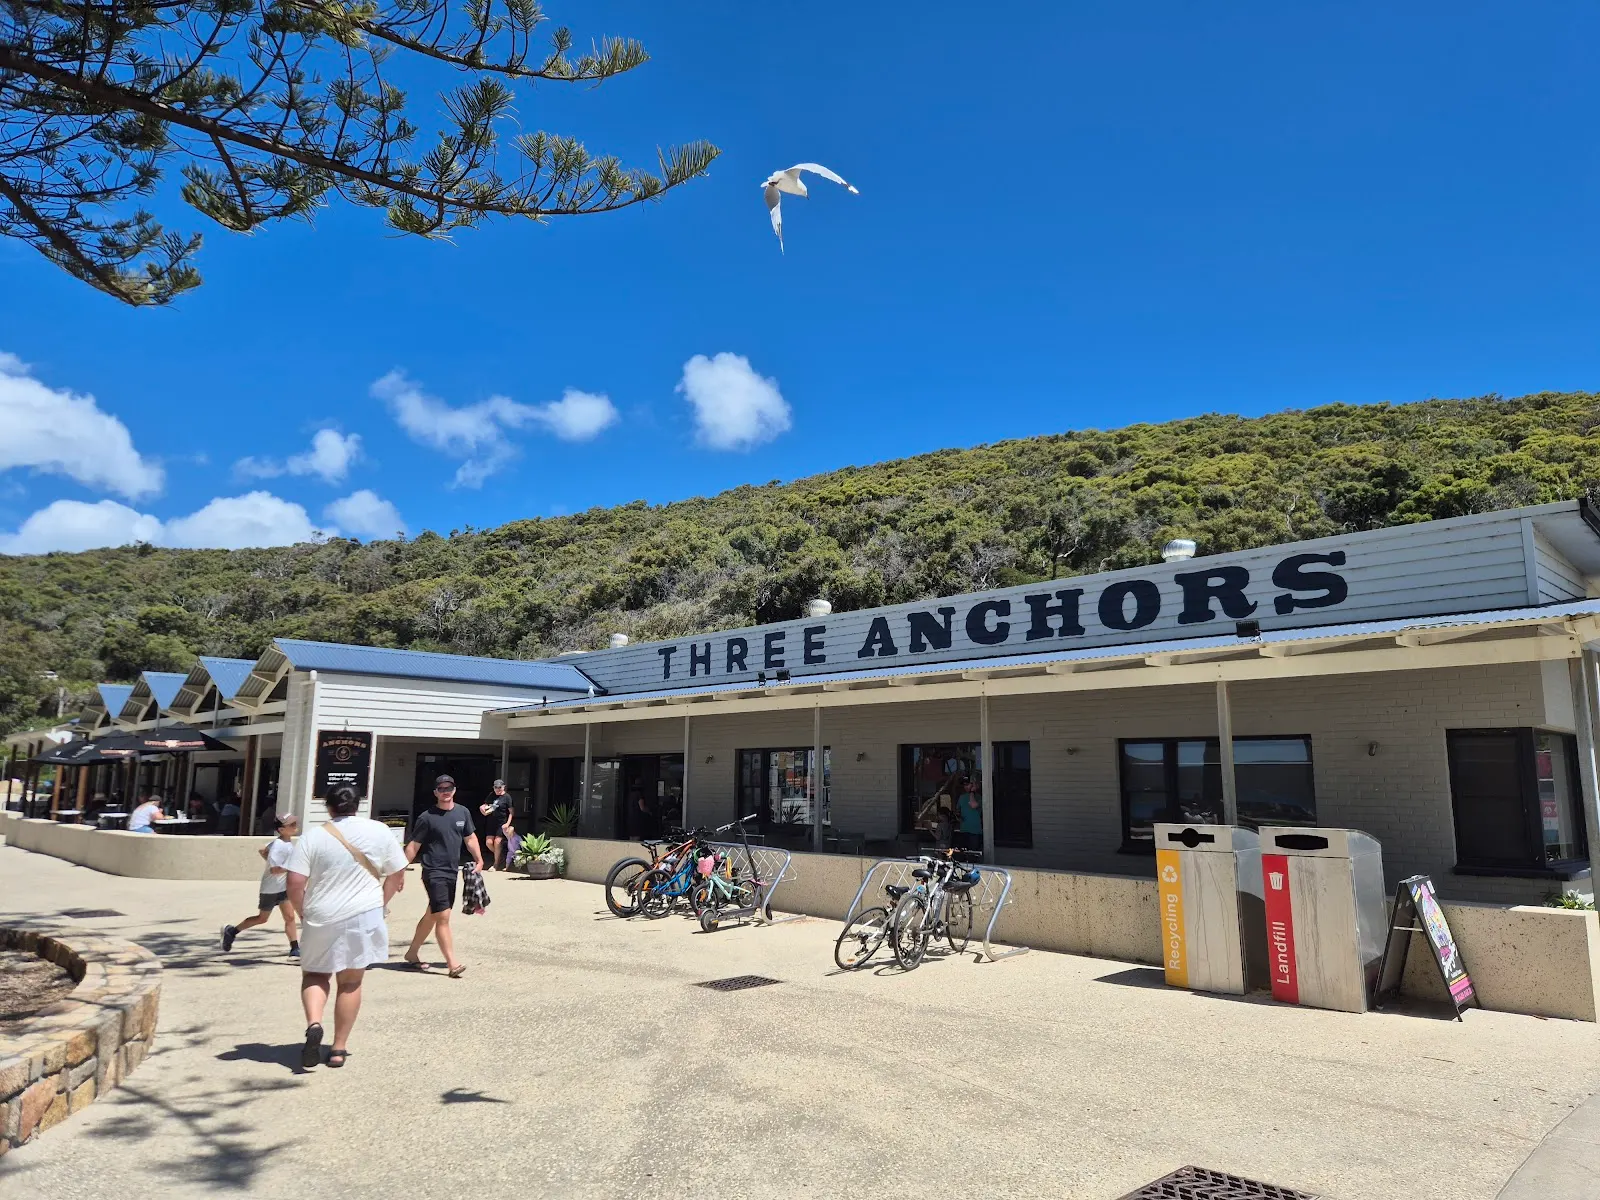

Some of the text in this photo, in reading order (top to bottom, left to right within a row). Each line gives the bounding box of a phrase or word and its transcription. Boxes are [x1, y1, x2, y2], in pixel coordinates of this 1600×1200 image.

[658, 552, 1348, 680] THREE ANCHORS
[1166, 893, 1182, 970] Recycling
[1272, 921, 1290, 985] Landfill
